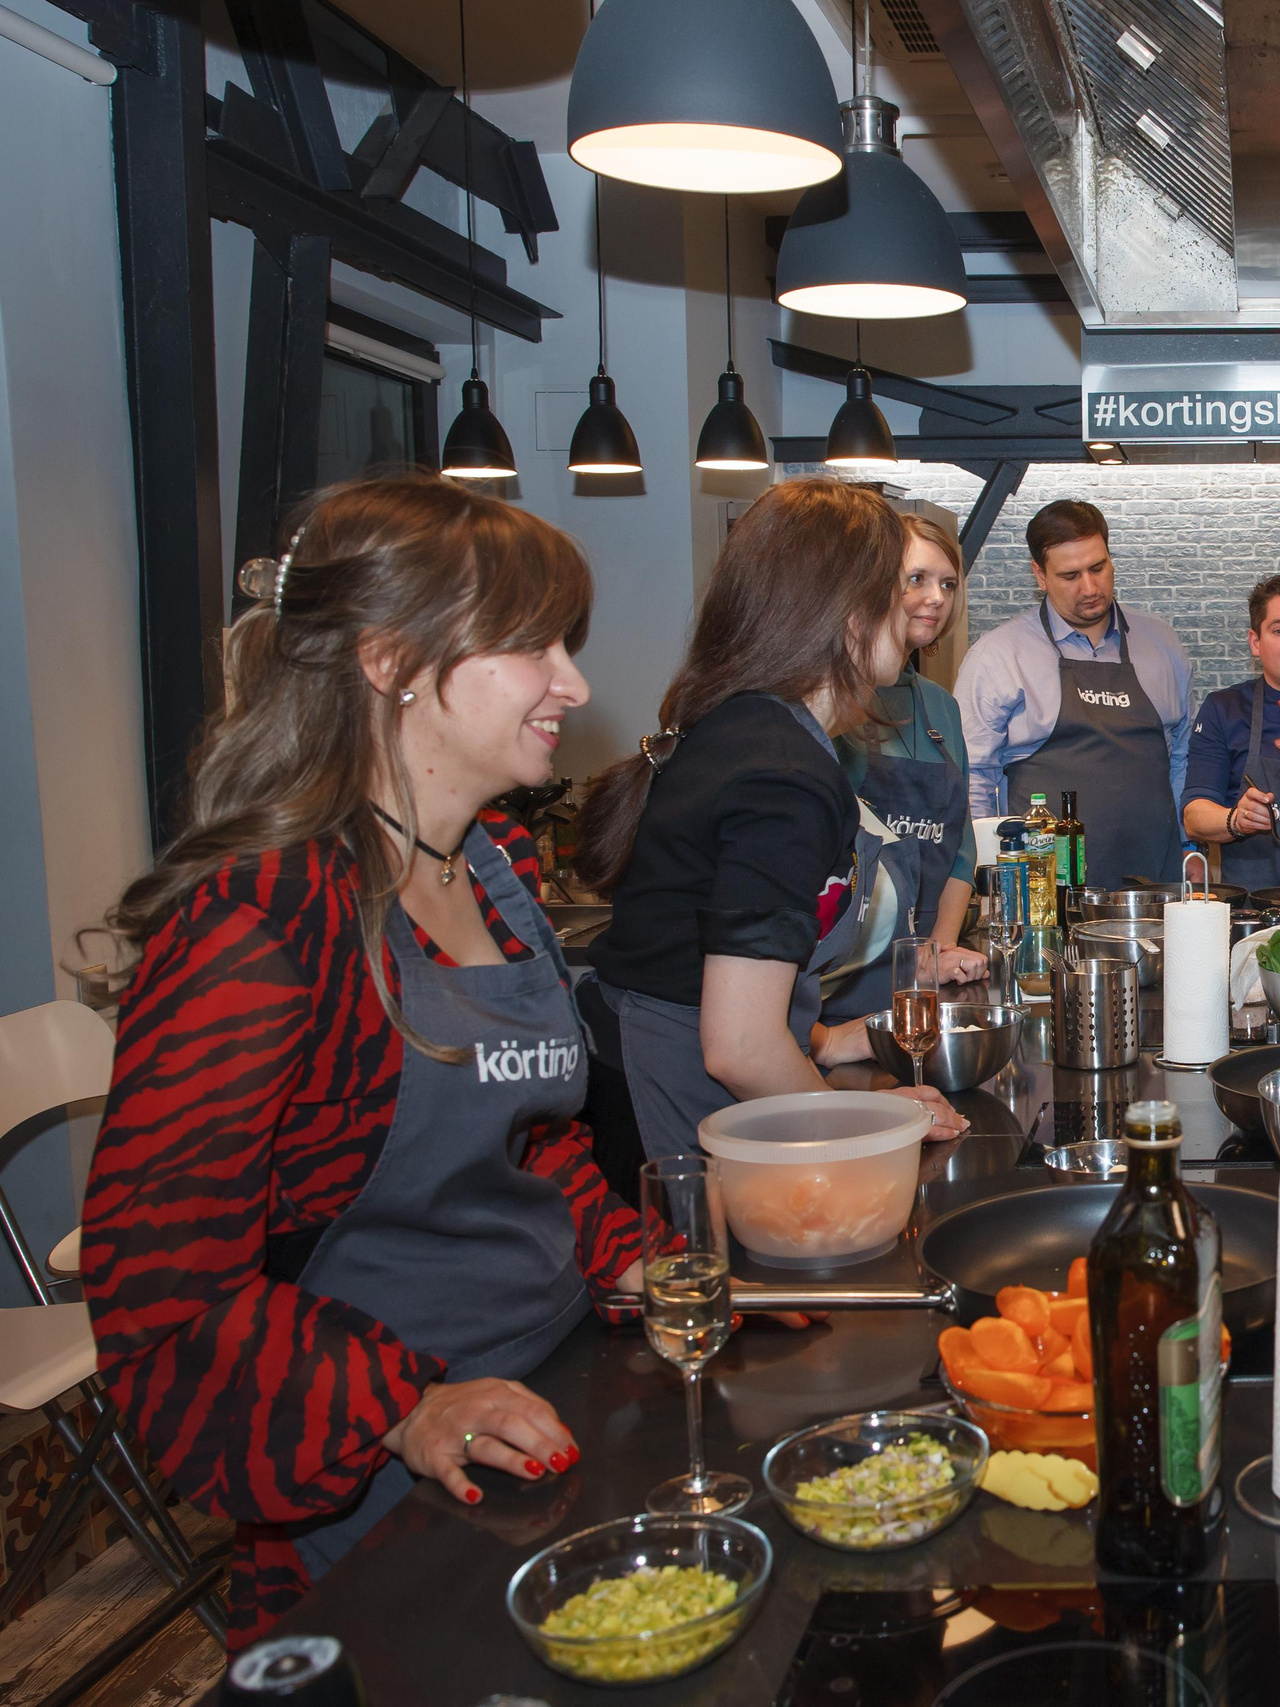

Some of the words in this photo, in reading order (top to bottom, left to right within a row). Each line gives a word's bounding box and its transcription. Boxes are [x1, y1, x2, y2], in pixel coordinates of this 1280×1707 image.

[1077, 687, 1131, 708] körting
[886, 813, 945, 844] körting
[475, 1039, 579, 1083] körting
